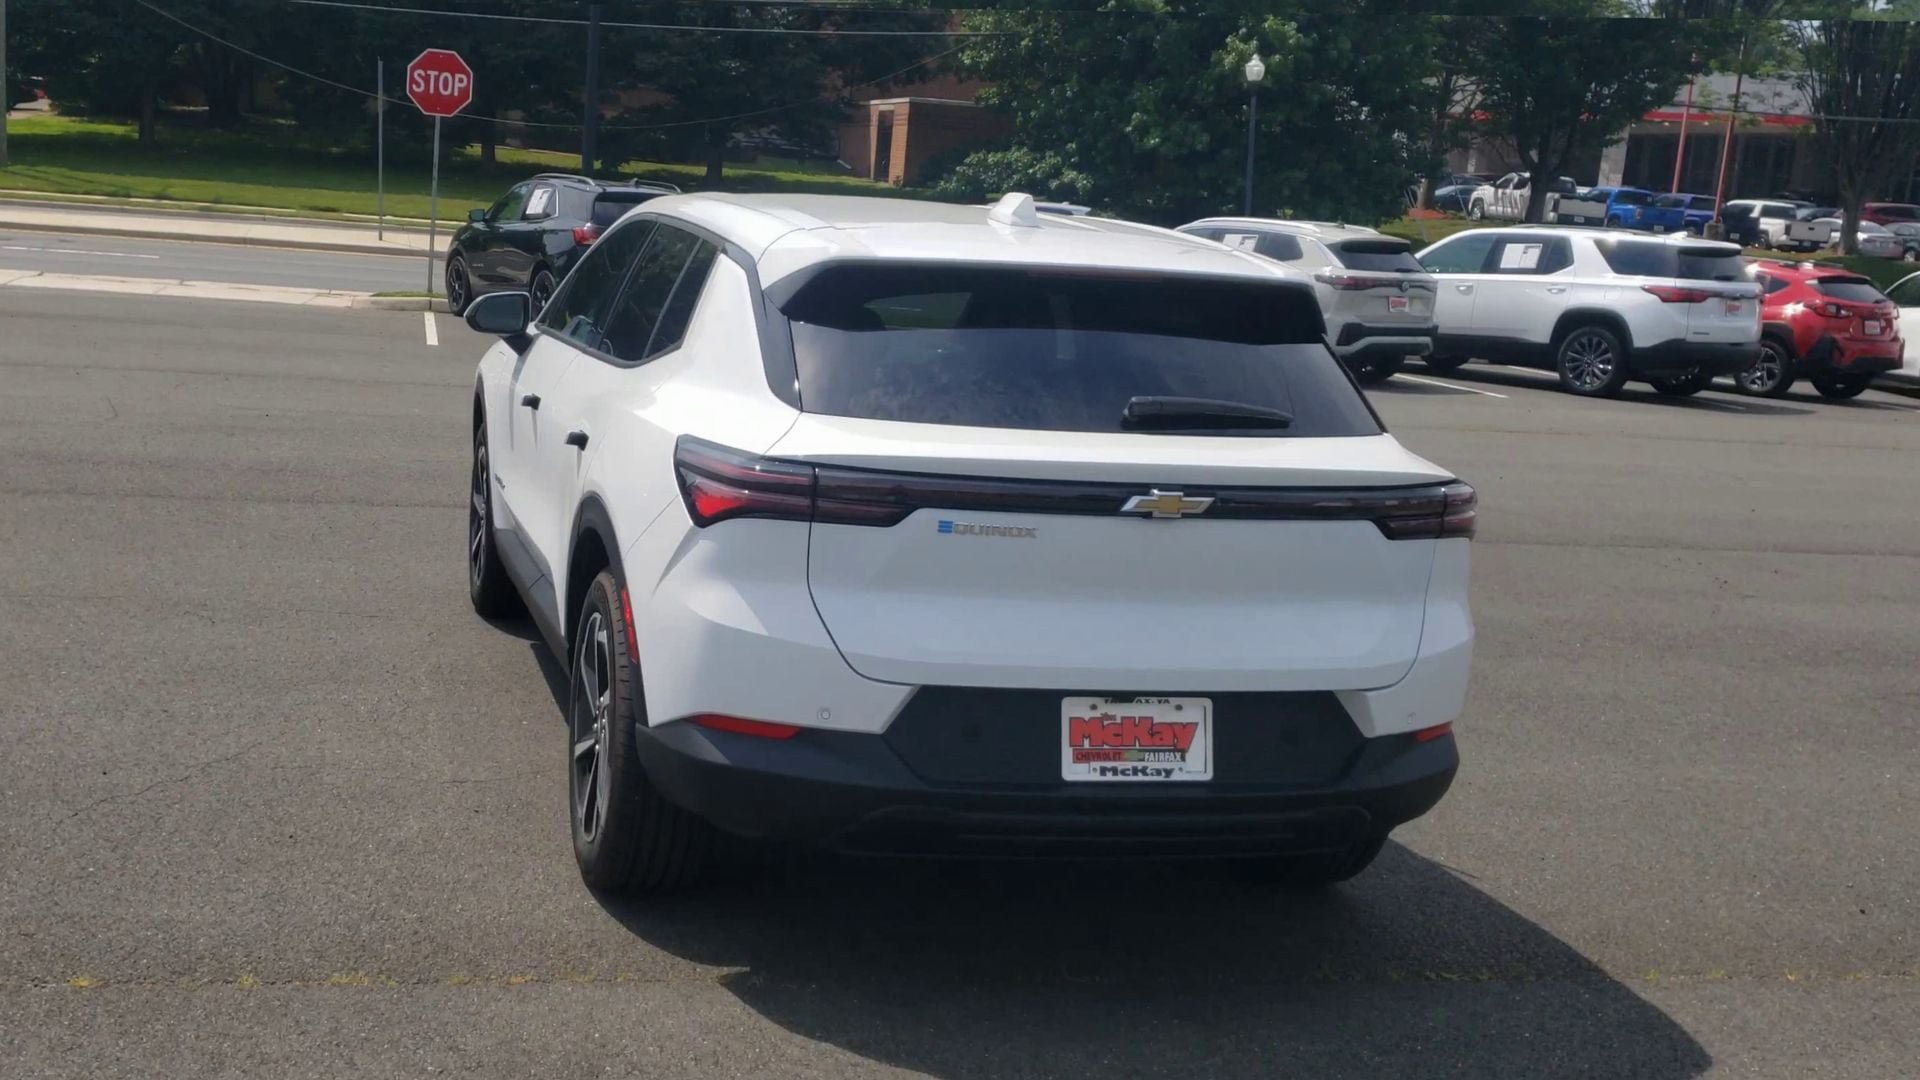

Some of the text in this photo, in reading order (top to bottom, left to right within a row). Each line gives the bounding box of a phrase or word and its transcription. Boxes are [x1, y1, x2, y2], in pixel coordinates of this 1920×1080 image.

[412, 69, 468, 97] STOP
[937, 520, 1038, 539] EQUINOX
[1069, 716, 1199, 753] McKay
[1145, 751, 1182, 762] FAIRFAX
[1099, 765, 1175, 779] McKay
